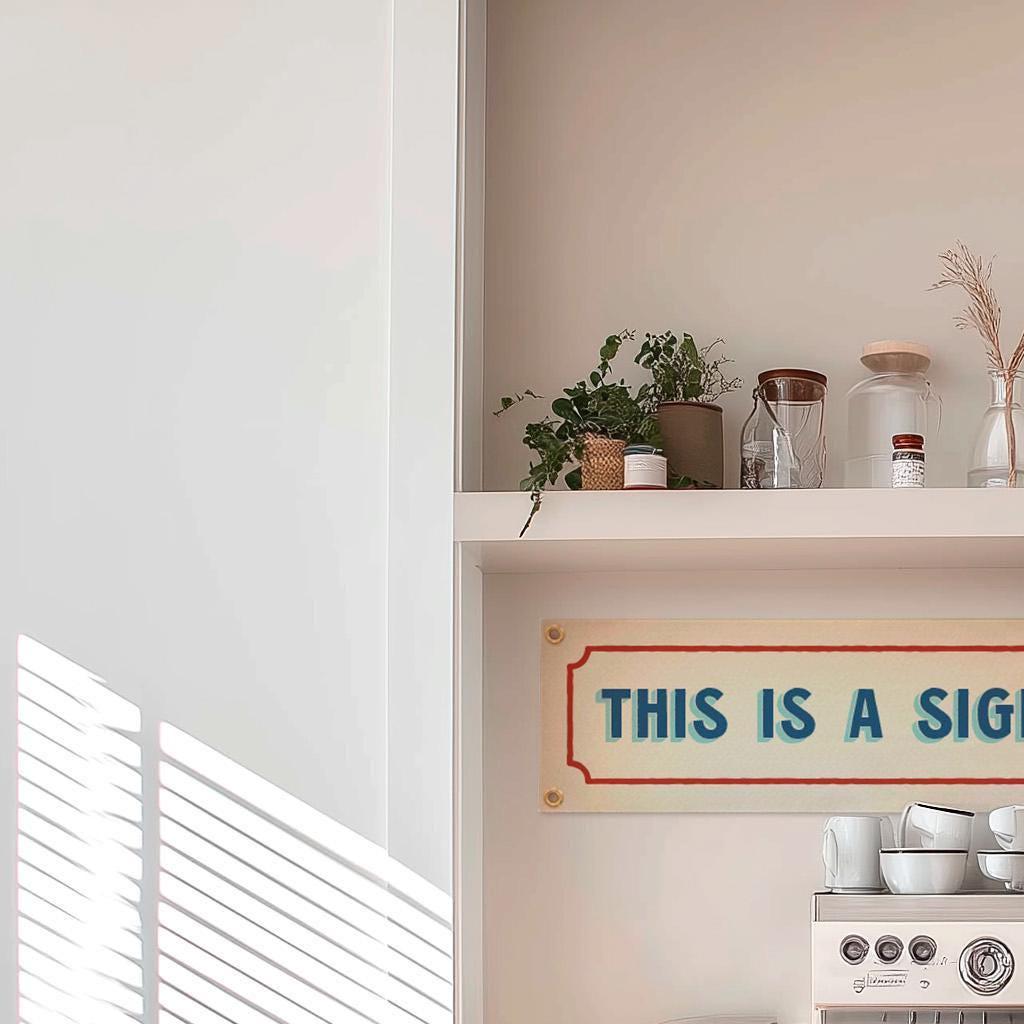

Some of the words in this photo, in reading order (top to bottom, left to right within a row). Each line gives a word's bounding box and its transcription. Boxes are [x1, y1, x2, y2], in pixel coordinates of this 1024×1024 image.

[598, 687, 728, 742] THIS
[759, 687, 816, 742] IS
[846, 688, 883, 741] A
